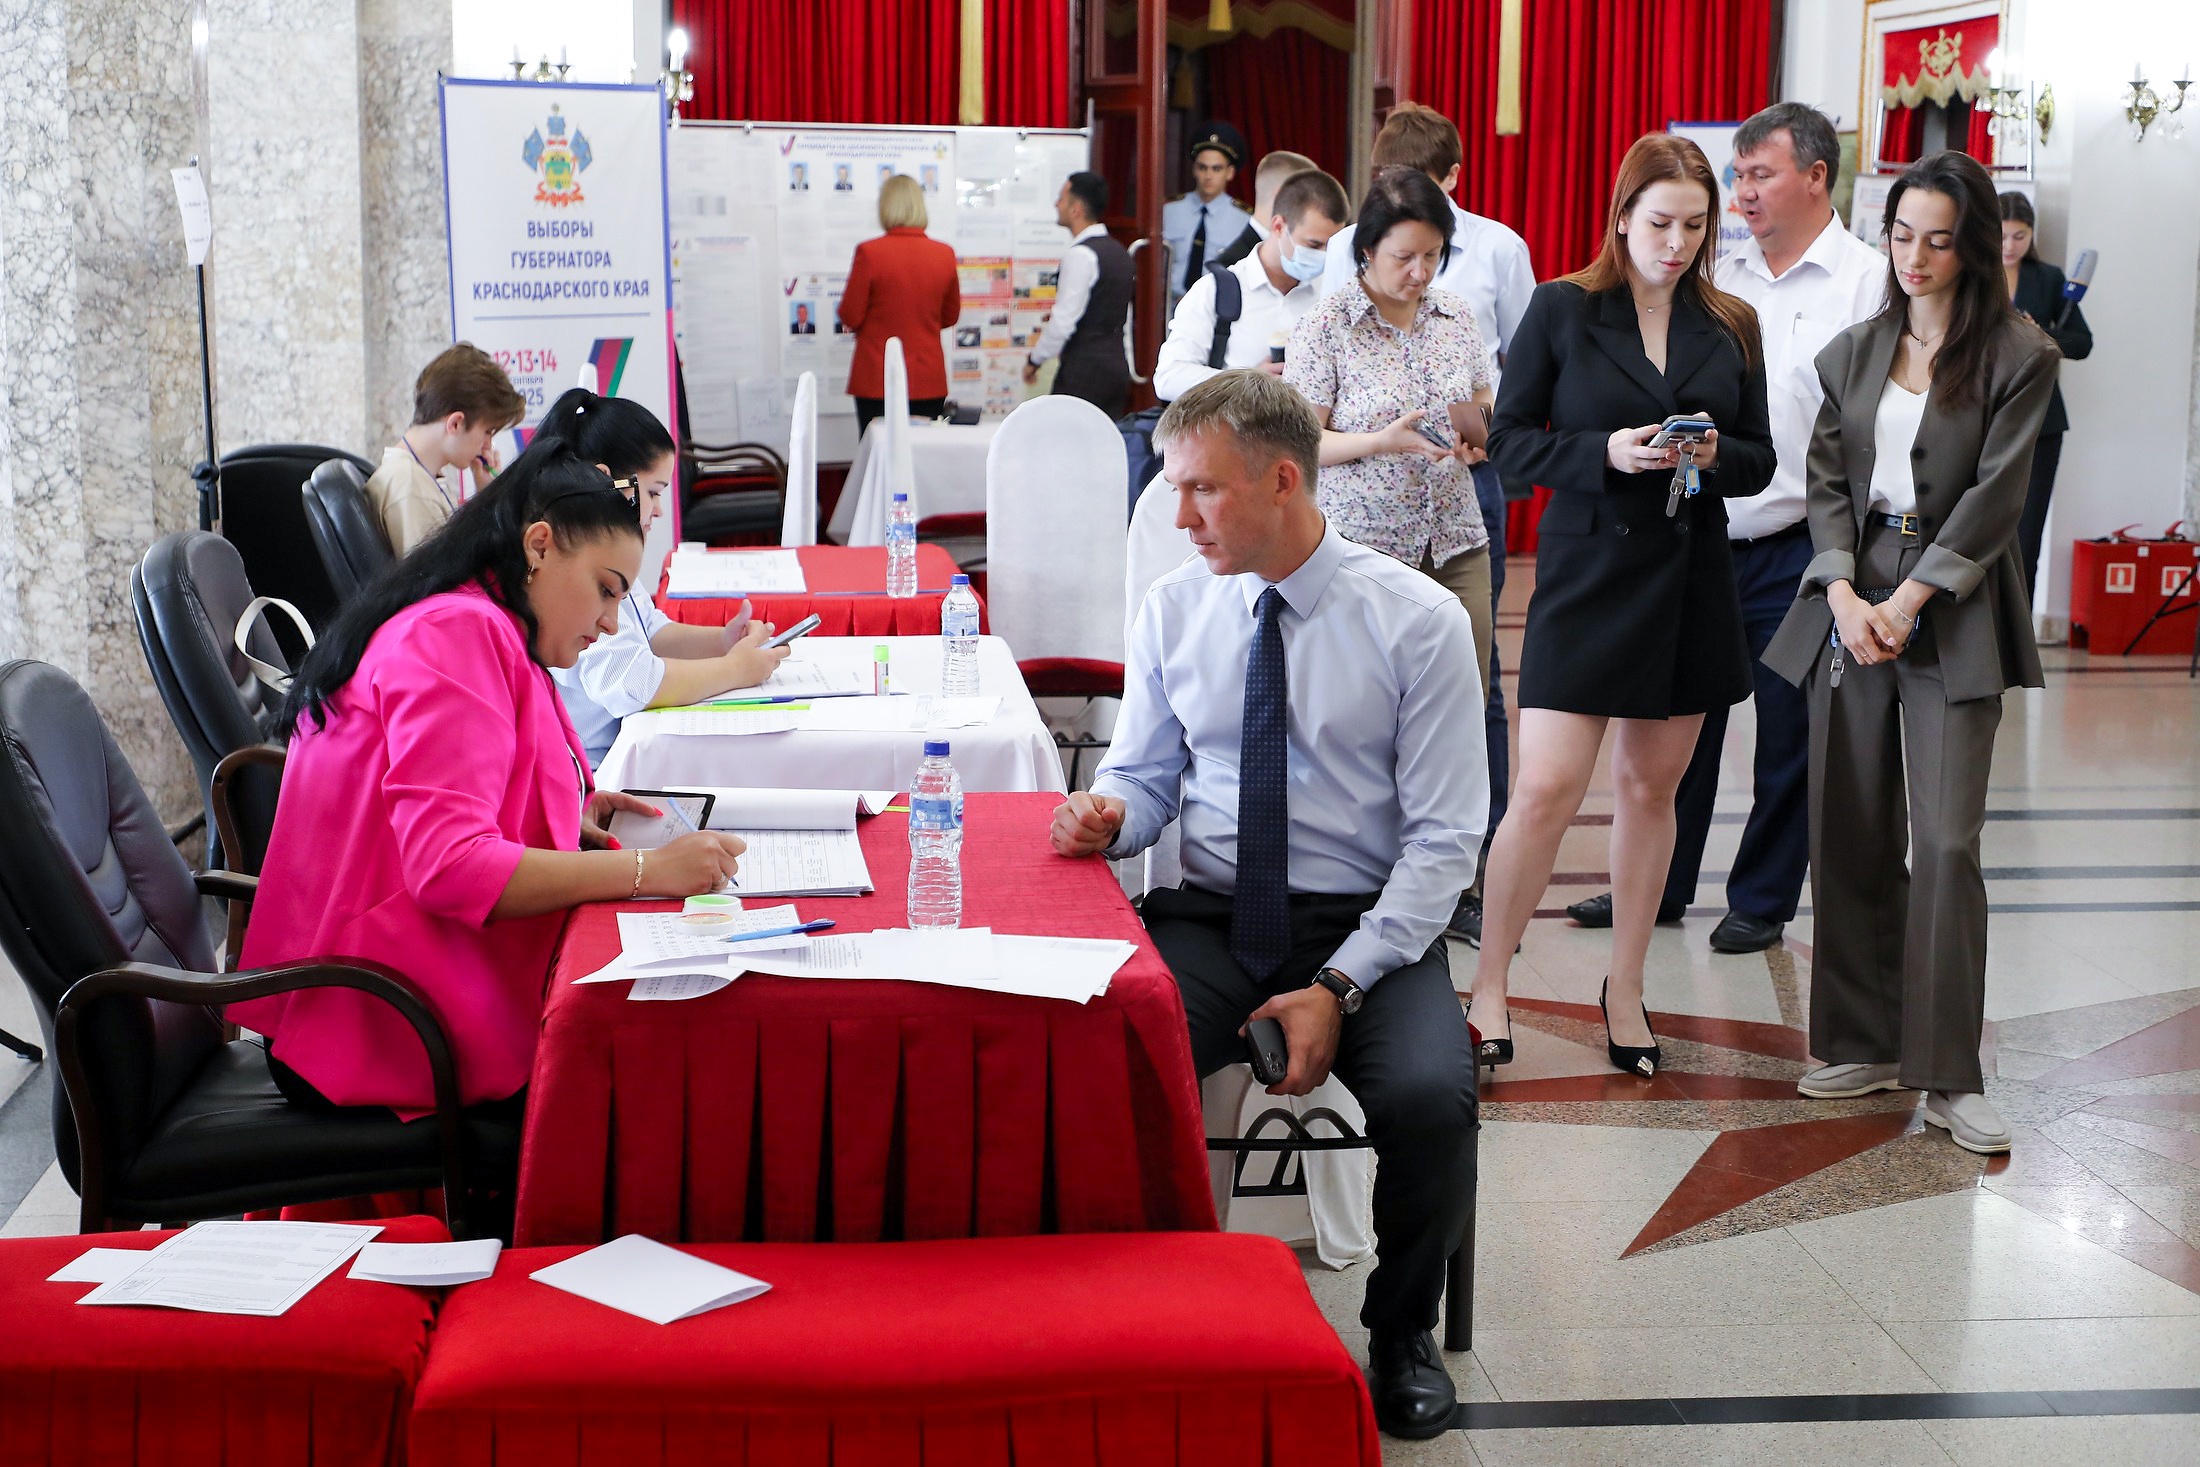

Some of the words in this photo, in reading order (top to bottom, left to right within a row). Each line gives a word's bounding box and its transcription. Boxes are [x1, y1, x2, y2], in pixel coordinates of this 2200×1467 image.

[527, 220, 593, 239] ВЫБОРЫ
[1721, 226, 1751, 240] ВЫБО
[511, 251, 612, 269] ГУБЕРНАТОРА
[473, 281, 609, 301] КРАСНОДАРСКОГО
[613, 279, 650, 297] КРАЯ
